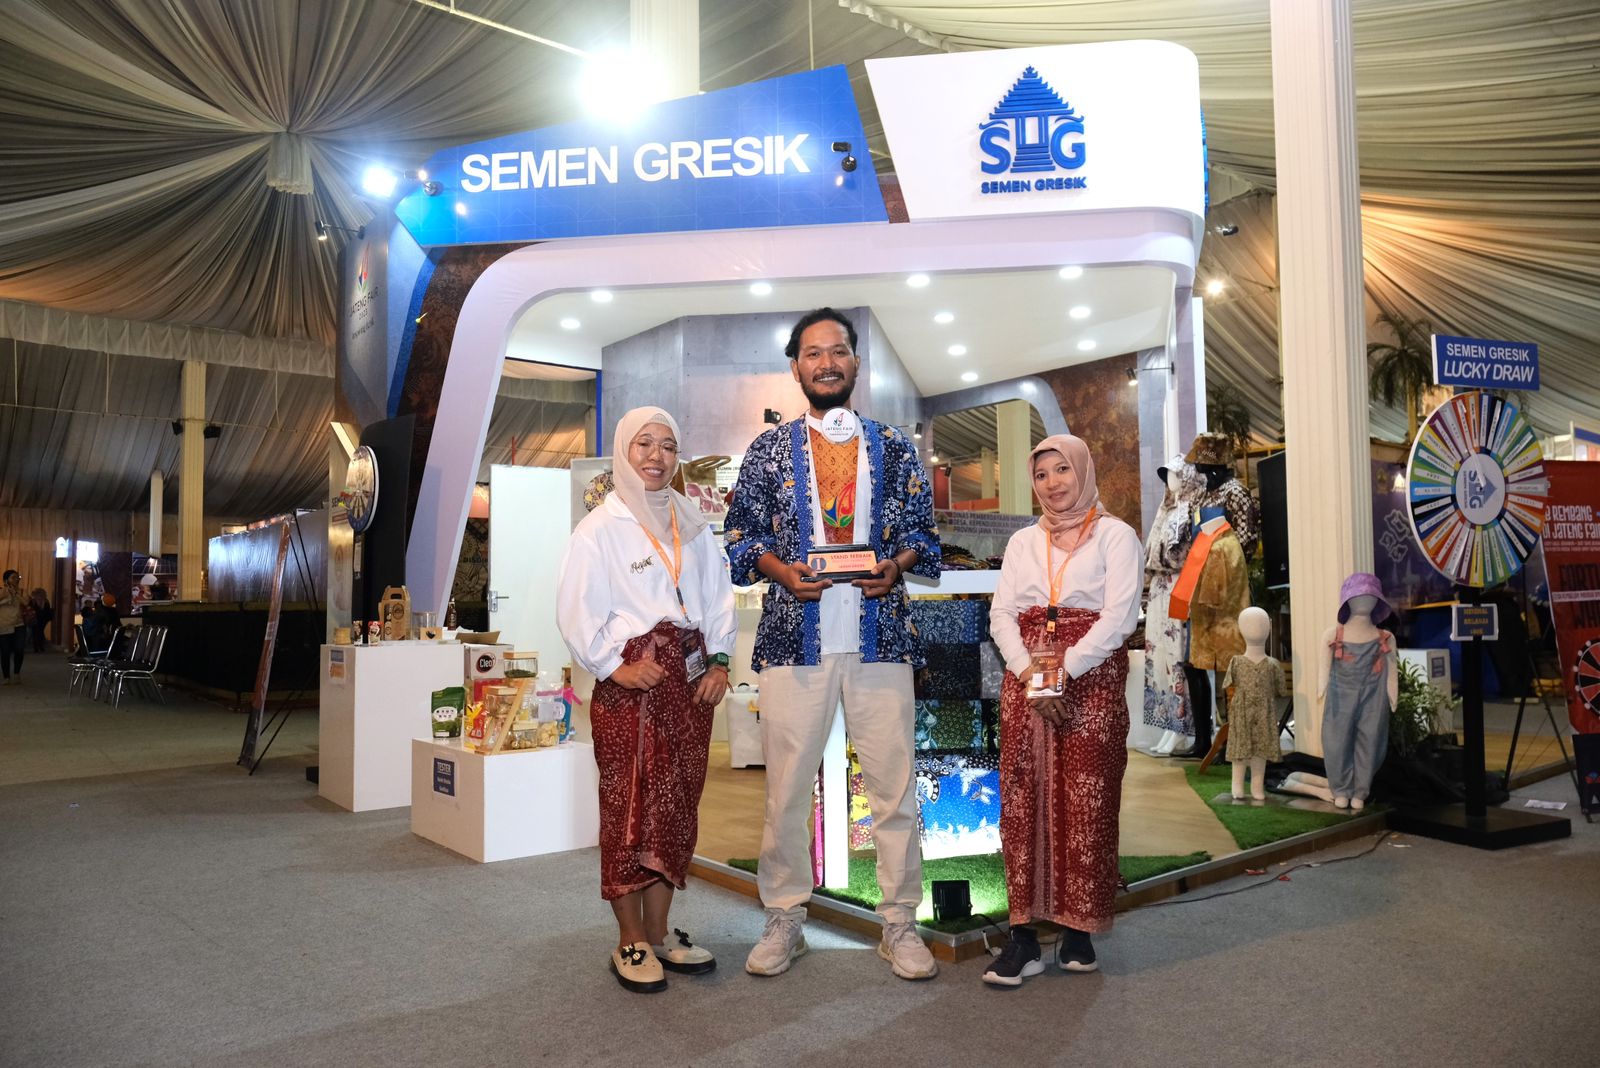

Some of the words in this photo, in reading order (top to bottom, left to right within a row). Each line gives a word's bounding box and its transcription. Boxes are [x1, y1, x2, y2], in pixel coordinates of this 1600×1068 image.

[460, 145, 619, 193] SEMEN
[633, 133, 812, 182] GRESIK
[981, 180, 1031, 194] SEMEN
[1034, 176, 1088, 191] GRESIK
[1446, 343, 1486, 359] SEMEN
[1489, 346, 1531, 362] GRESIK
[1443, 360, 1491, 379] LUCKY
[1492, 363, 1535, 383] DRAW
[479, 658, 493, 669] Cleo
